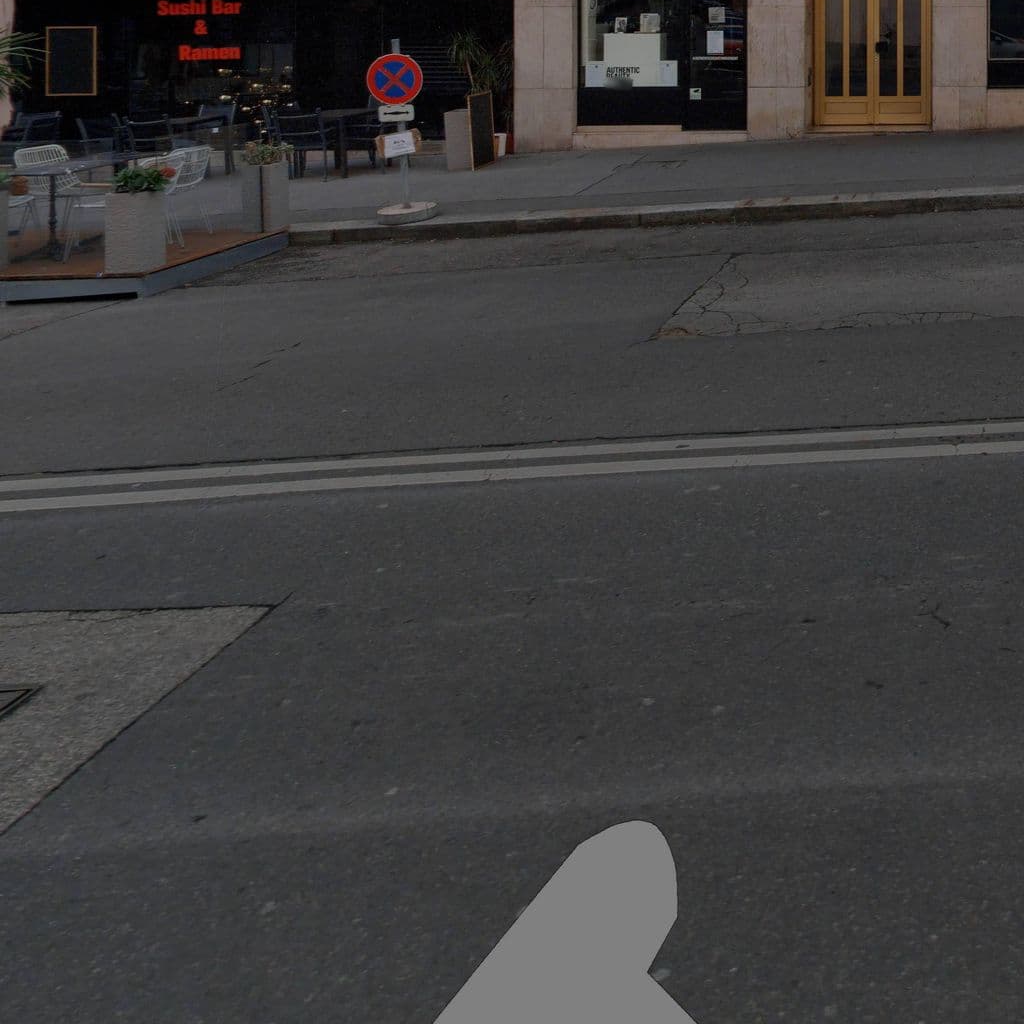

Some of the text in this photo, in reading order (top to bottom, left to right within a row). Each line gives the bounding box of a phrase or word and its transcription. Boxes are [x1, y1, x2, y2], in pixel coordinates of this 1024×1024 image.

[156, 0, 242, 16] Sushi Bar
[192, 18, 208, 36] &
[178, 44, 241, 62] Ramen
[606, 66, 641, 74] AUTHENTIC
